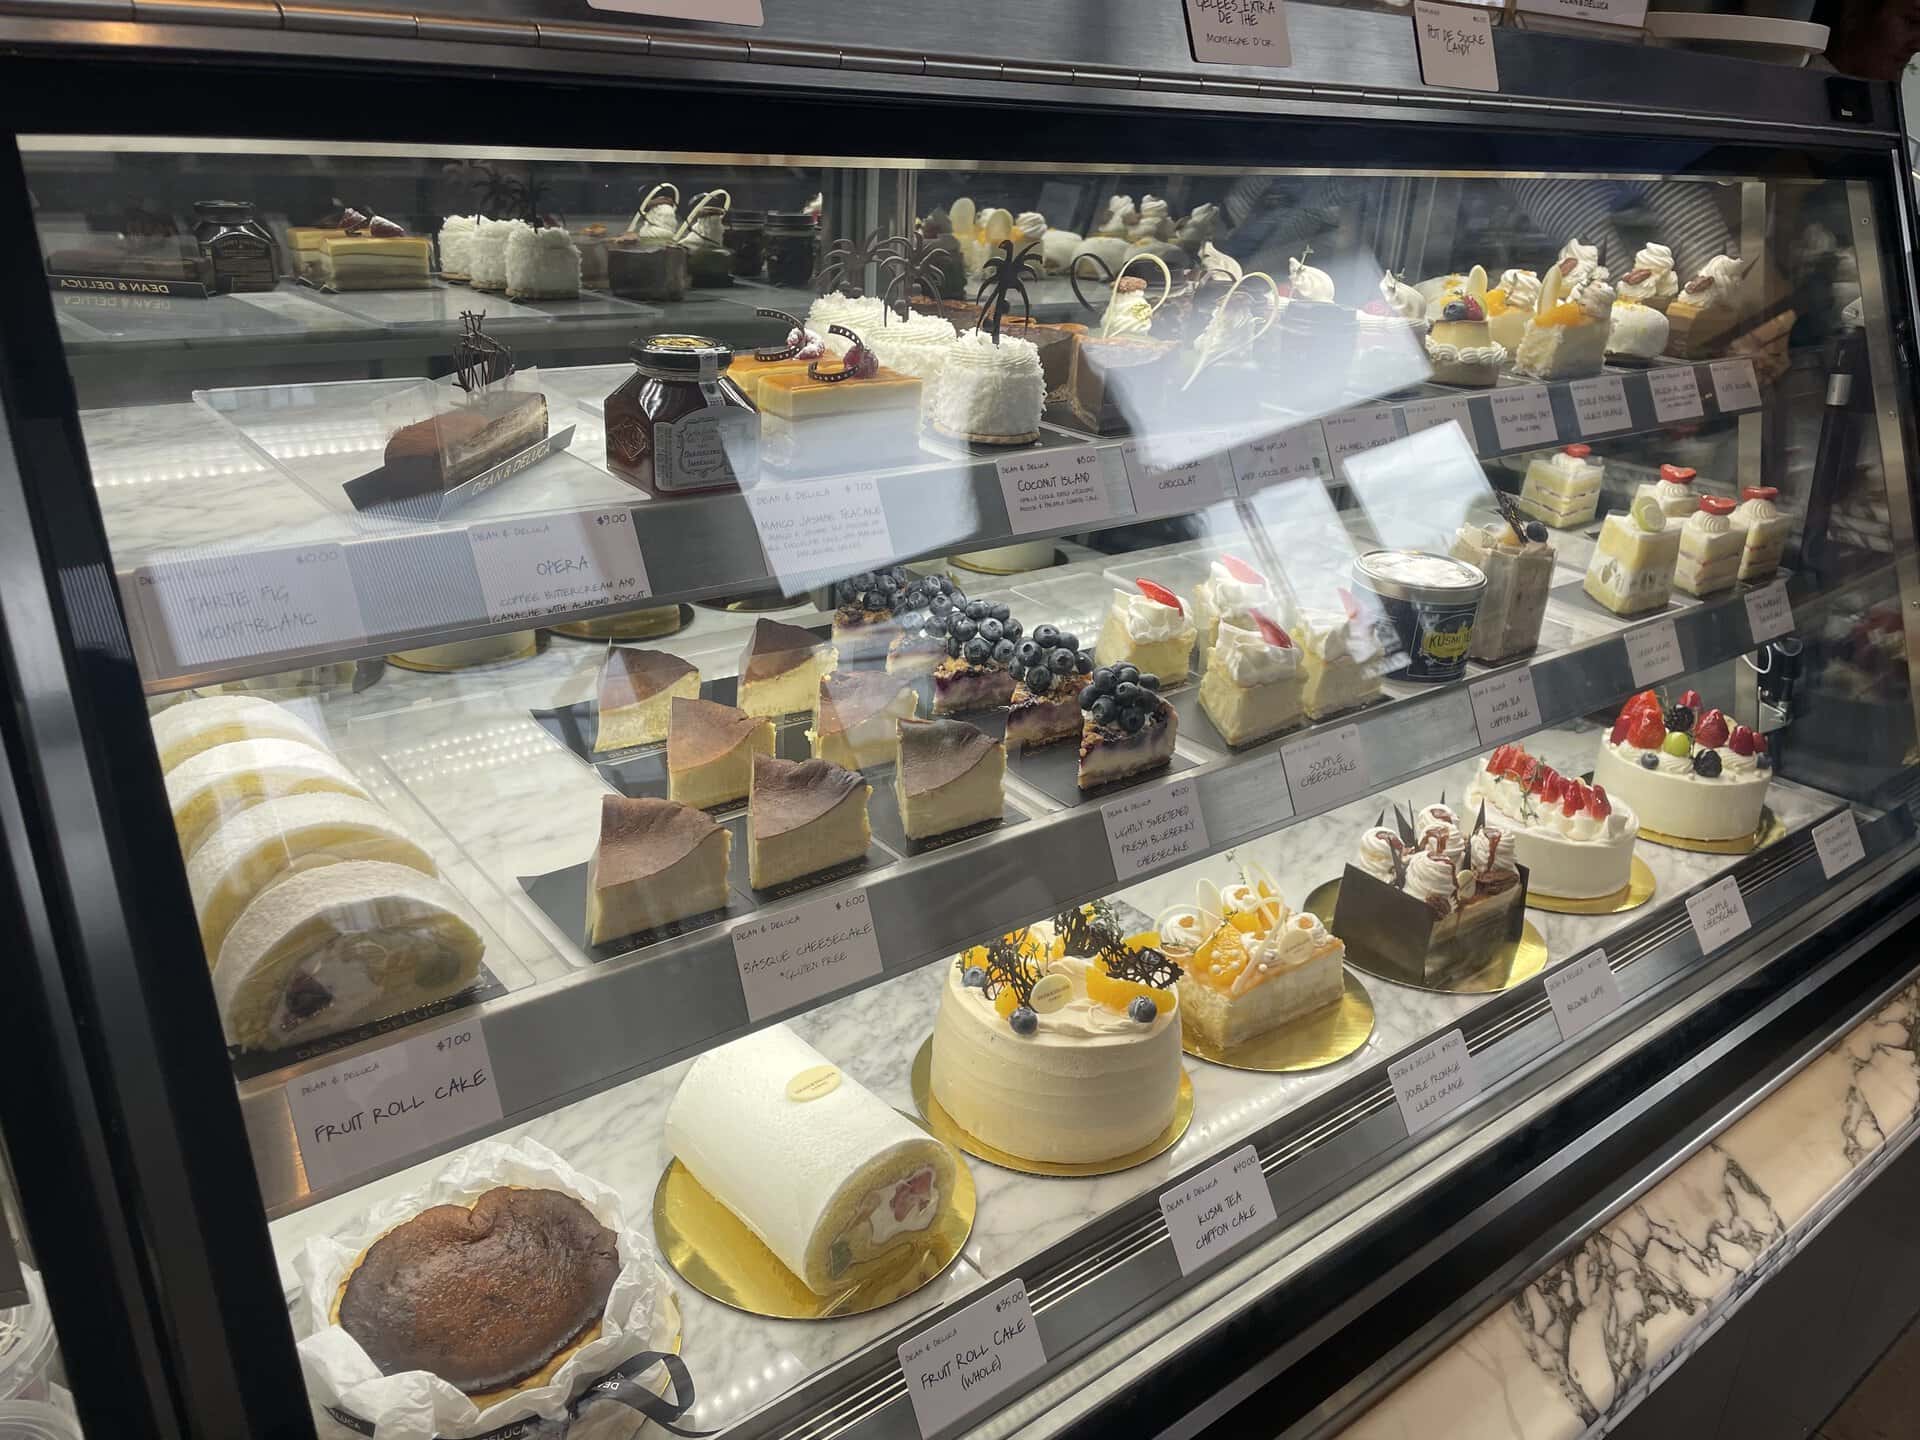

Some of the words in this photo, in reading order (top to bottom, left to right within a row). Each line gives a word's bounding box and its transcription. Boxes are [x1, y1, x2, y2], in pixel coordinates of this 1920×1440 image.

[1218, 10, 1233, 24] DE
[1017, 475, 1057, 492] COCONUT
[1061, 471, 1090, 487] ISLAND
[536, 555, 590, 577] OPERA
[618, 577, 636, 587] AND
[1121, 838, 1149, 856] FRESH
[1150, 819, 1195, 844] BLUEBERRY
[1136, 841, 1190, 868] CHEESECAKE
[743, 951, 791, 975] BASQUE
[796, 922, 873, 957] CHEESECAKE
[821, 951, 849, 966] FREE
[314, 1112, 364, 1143] FRUIT
[373, 1096, 425, 1125] ROLL
[434, 1068, 488, 1101] CAKE
[1224, 1190, 1243, 1209] TEA
[1231, 1203, 1258, 1228] CAKE
[920, 1361, 953, 1391] FRUIT
[955, 1344, 990, 1370] ROLL
[993, 1318, 1027, 1347] CAKE
[960, 1354, 1003, 1392] (WHOLE)
